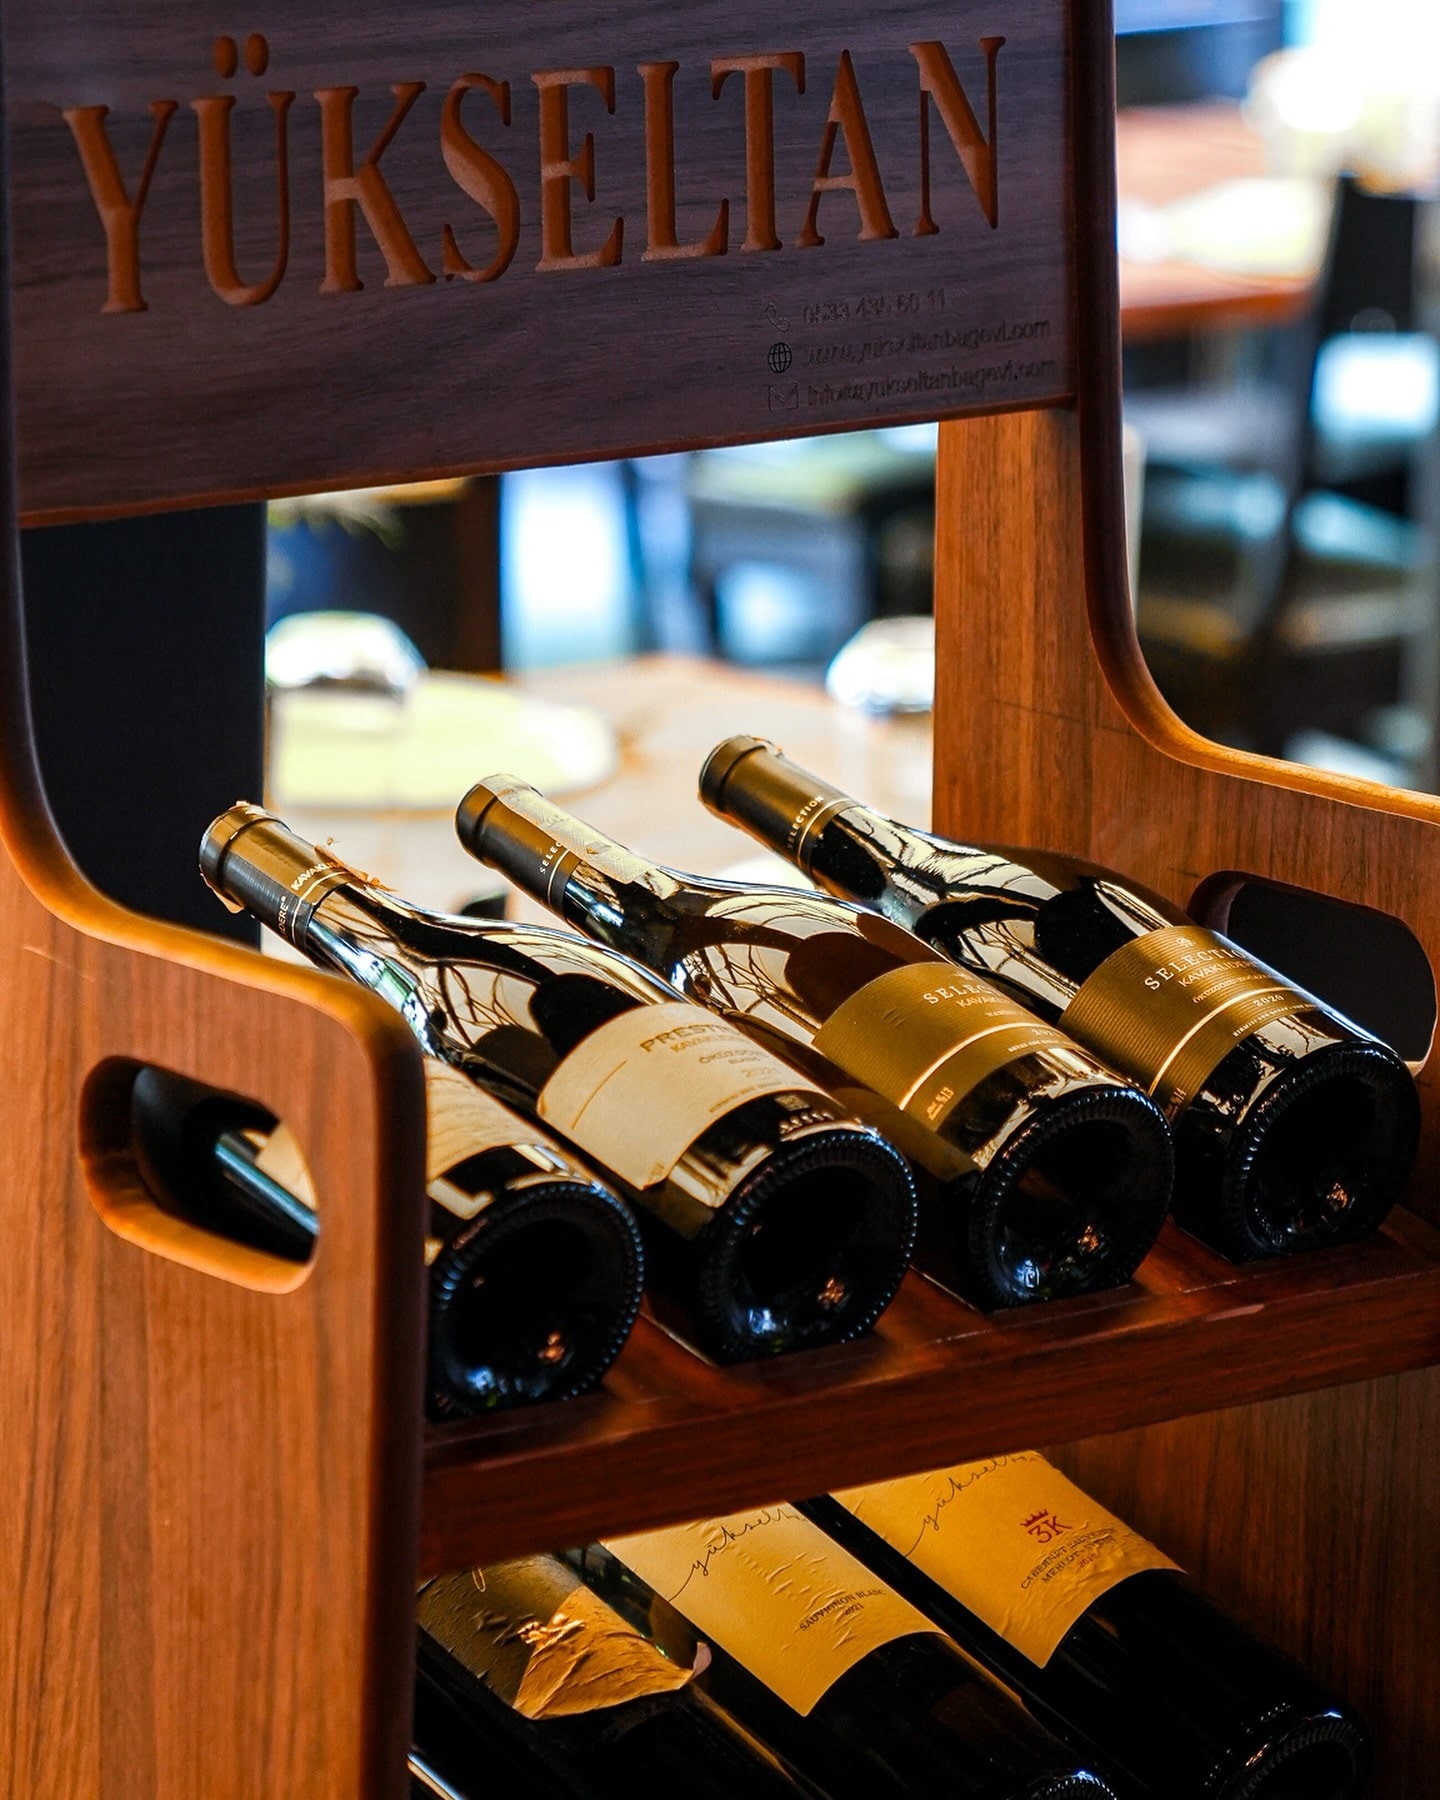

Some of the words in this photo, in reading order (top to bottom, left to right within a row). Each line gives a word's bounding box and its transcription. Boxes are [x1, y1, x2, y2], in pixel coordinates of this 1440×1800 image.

[63, 33, 1005, 313] YÜKSELTAN
[1027, 1515, 1073, 1544] 3K
[800, 1594, 857, 1632] SAUVIGNON
